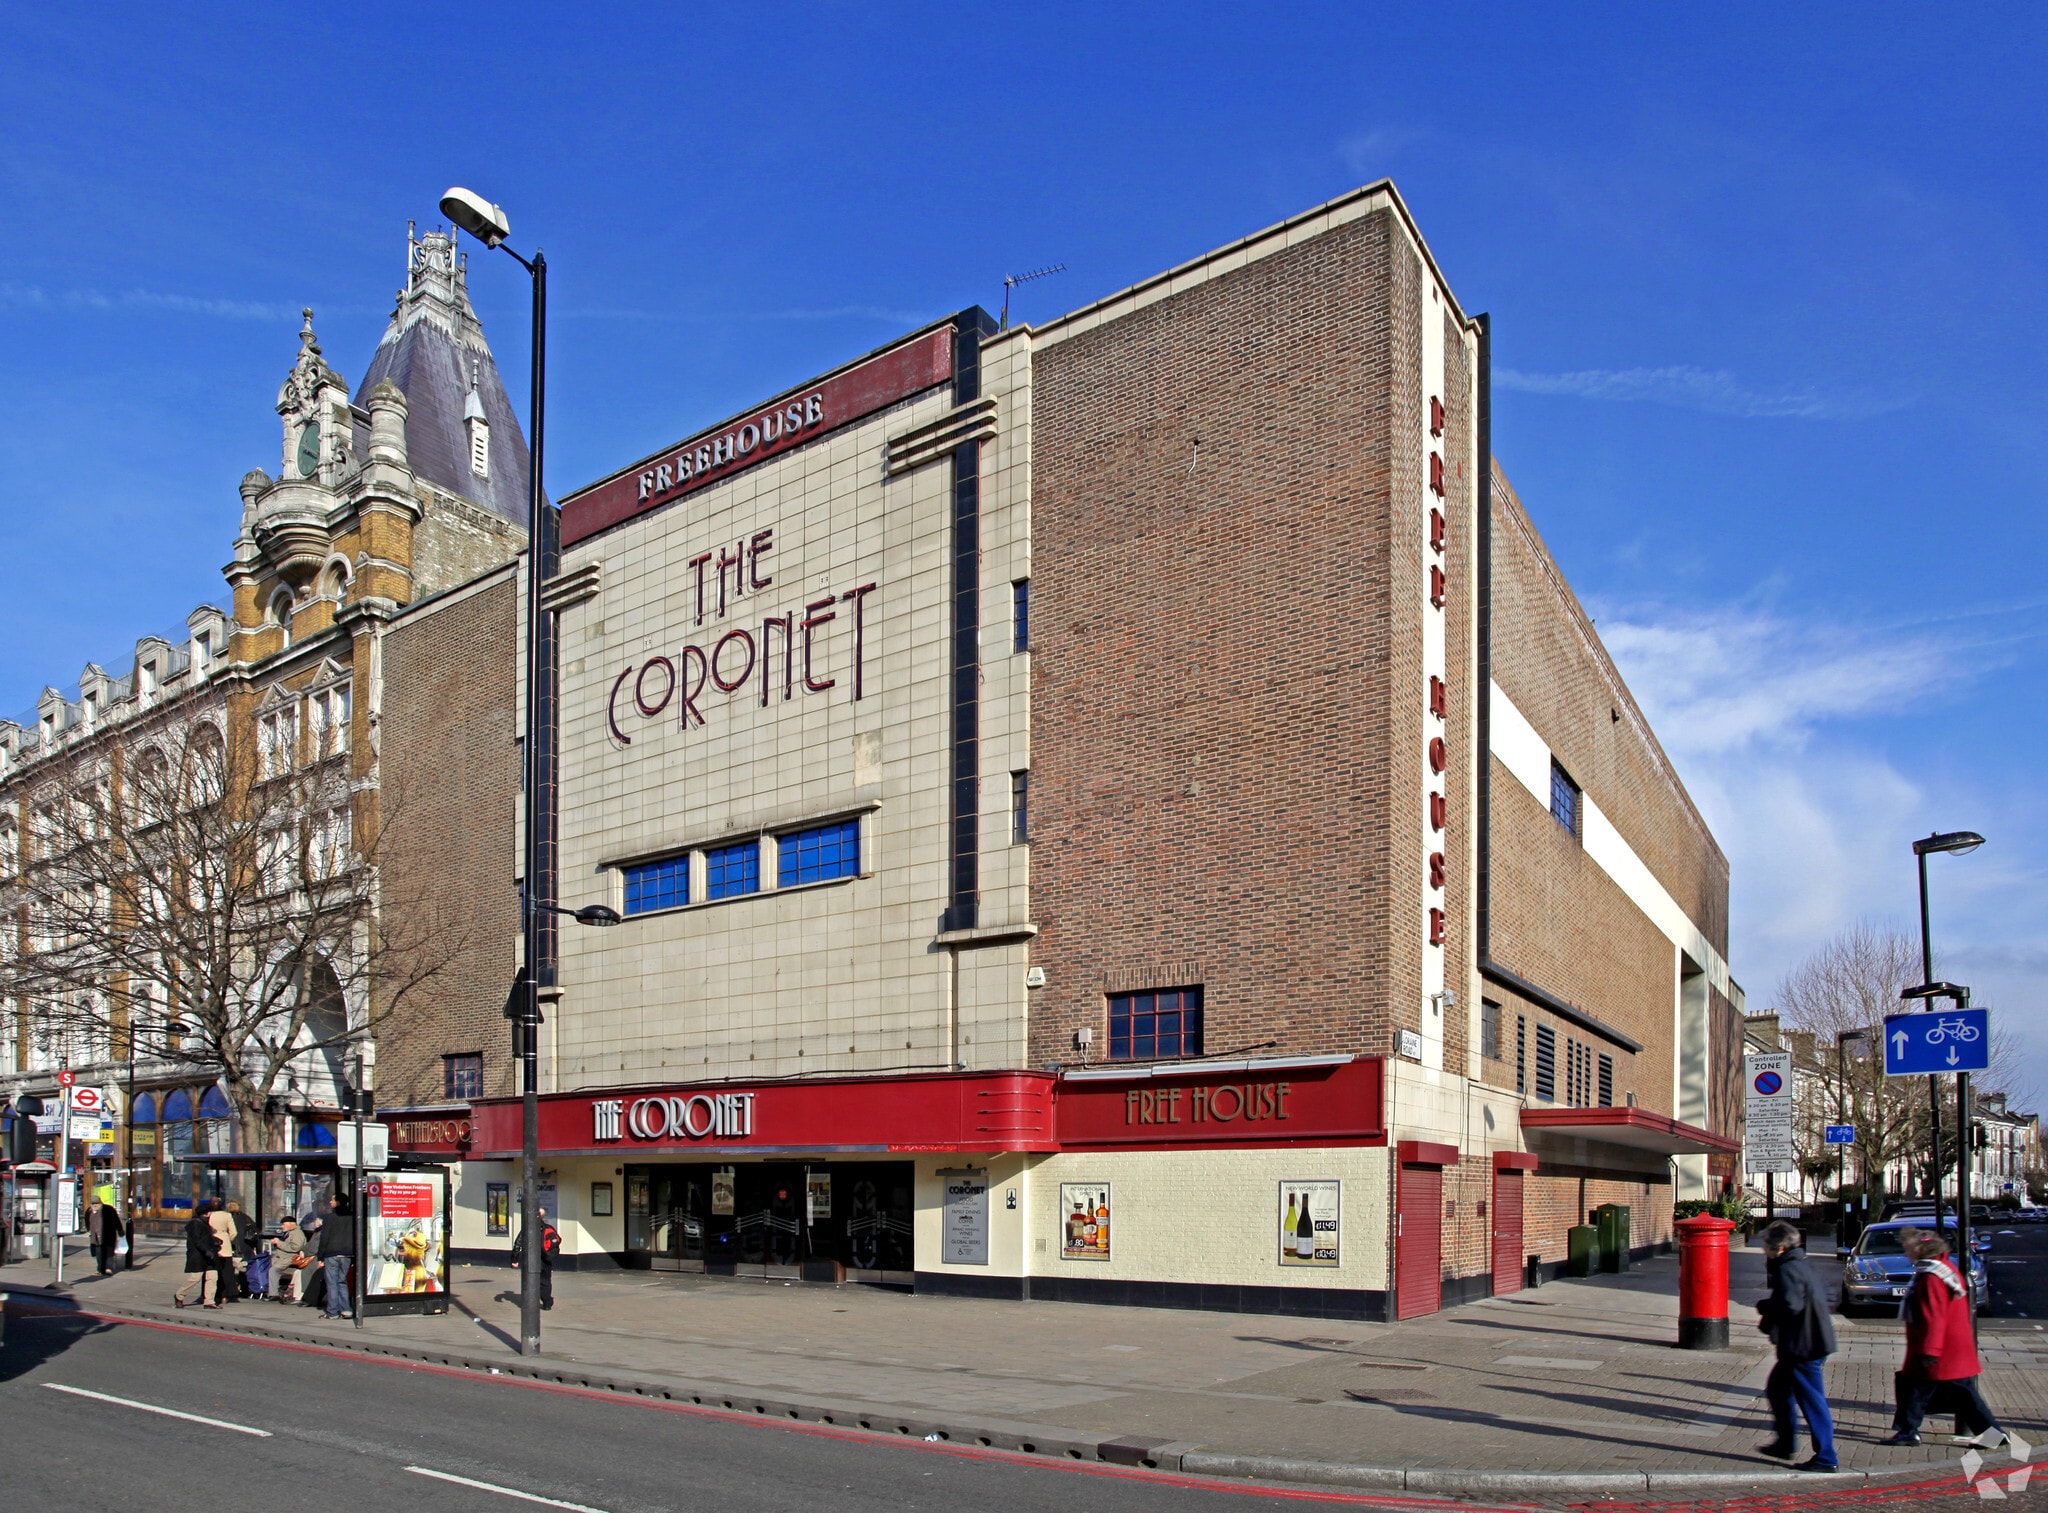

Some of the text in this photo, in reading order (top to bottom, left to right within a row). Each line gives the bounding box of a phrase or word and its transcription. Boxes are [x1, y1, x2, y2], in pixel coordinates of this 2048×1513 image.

[637, 393, 824, 501] FREEHOUSE
[689, 529, 773, 626] THE
[608, 582, 877, 746] CORONET
[1428, 394, 1446, 947] FREE HOUSE
[63, 1073, 71, 1083] S
[1748, 1055, 1787, 1063] Controlled
[1754, 1062, 1781, 1070] ZONE
[592, 1092, 754, 1139] THE CORONET
[1126, 1081, 1291, 1125] FREE HOUSE
[948, 1186, 985, 1195] CORONET
